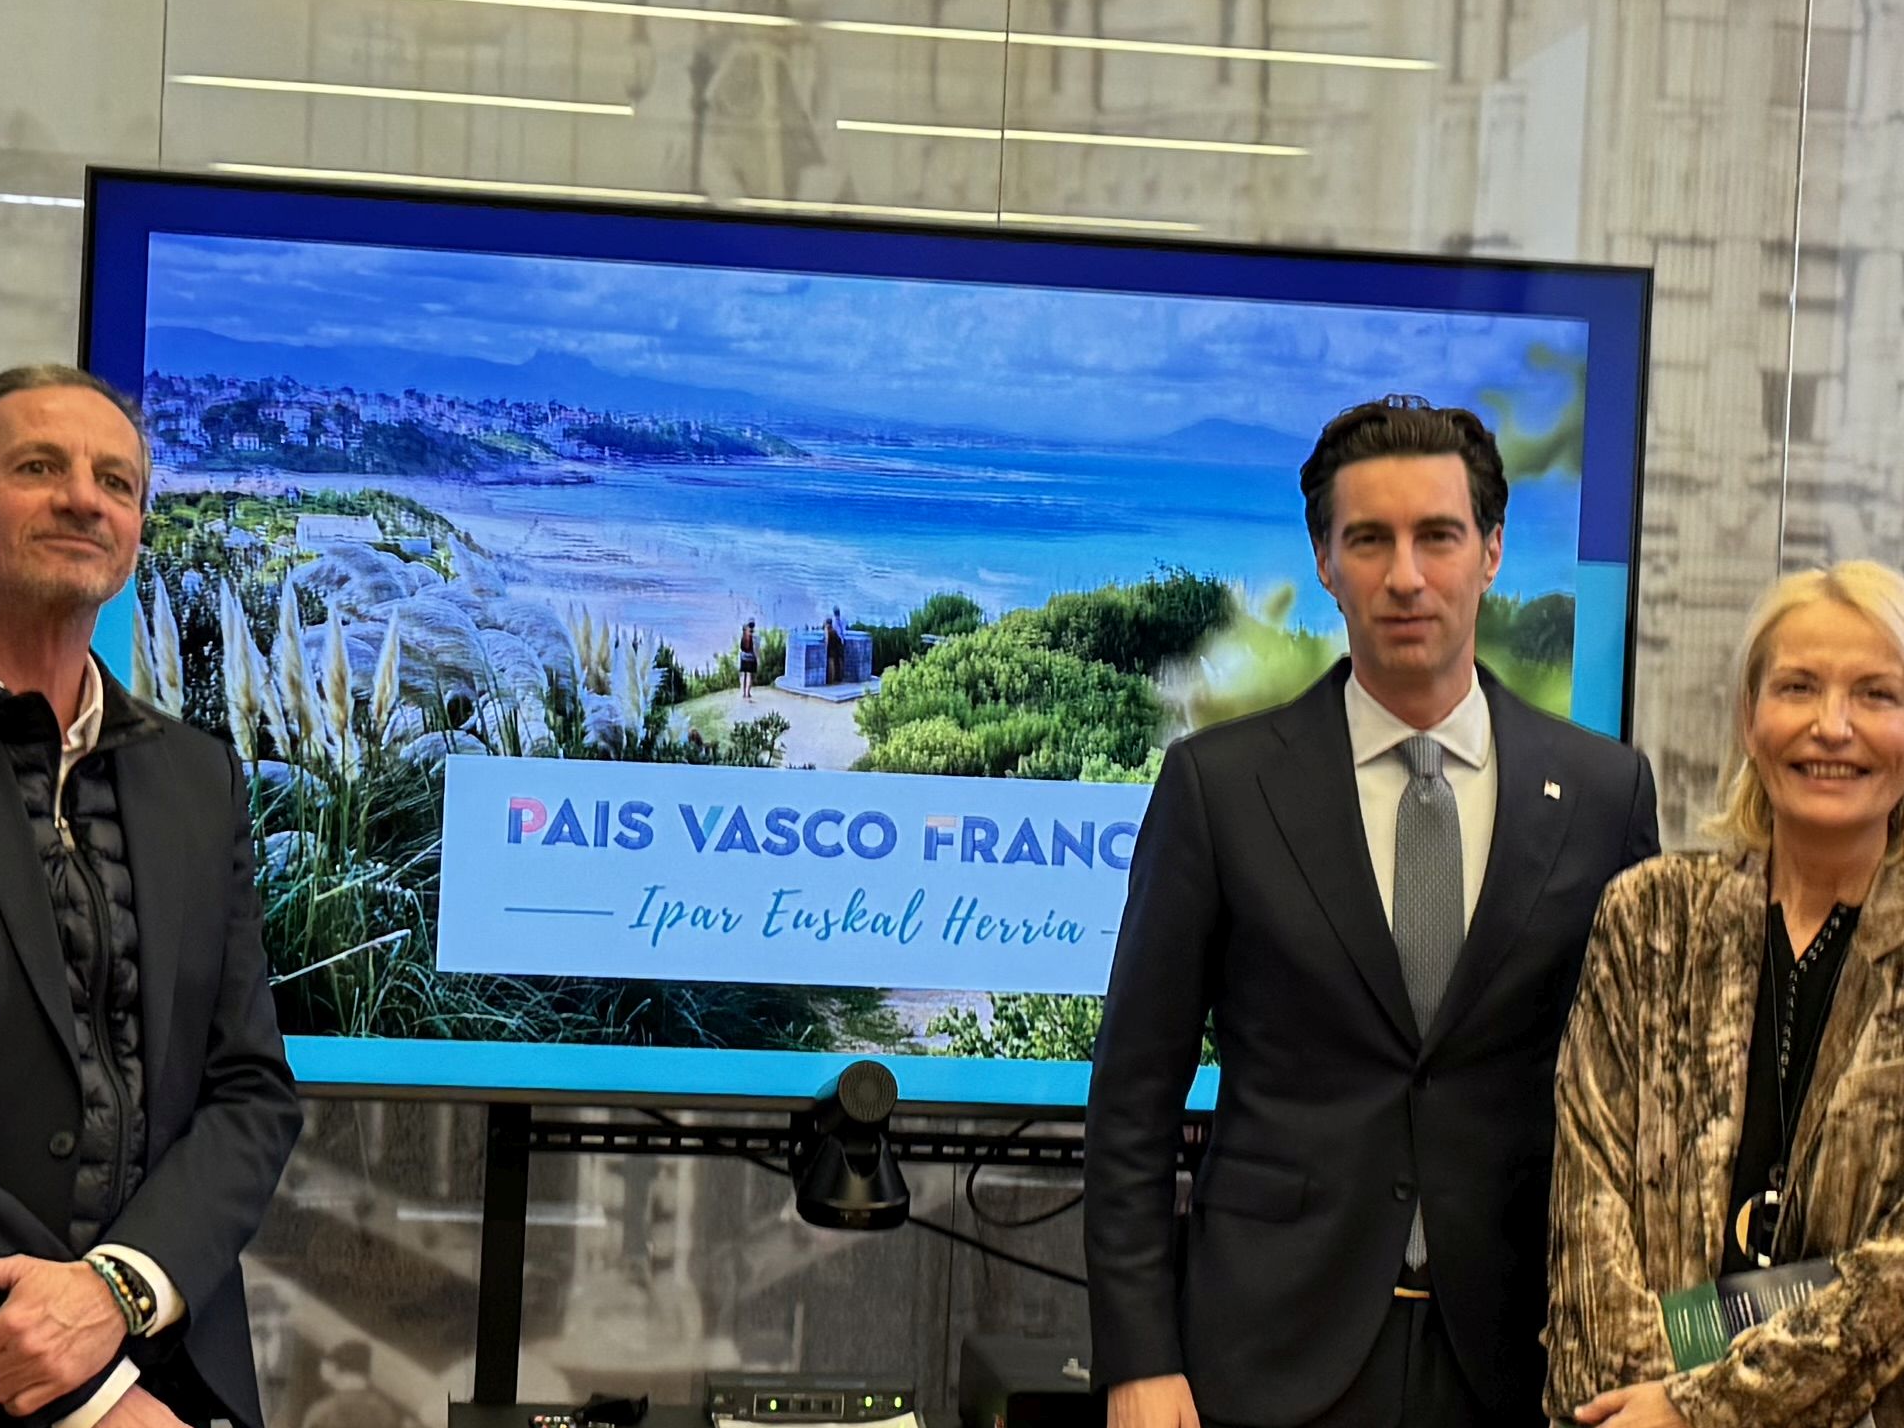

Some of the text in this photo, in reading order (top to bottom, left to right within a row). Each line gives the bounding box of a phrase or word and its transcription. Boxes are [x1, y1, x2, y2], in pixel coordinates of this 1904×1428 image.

[507, 796, 654, 851] PAIS
[678, 803, 898, 860] VASCO
[628, 884, 1086, 948] Ipar Euskal Herria
